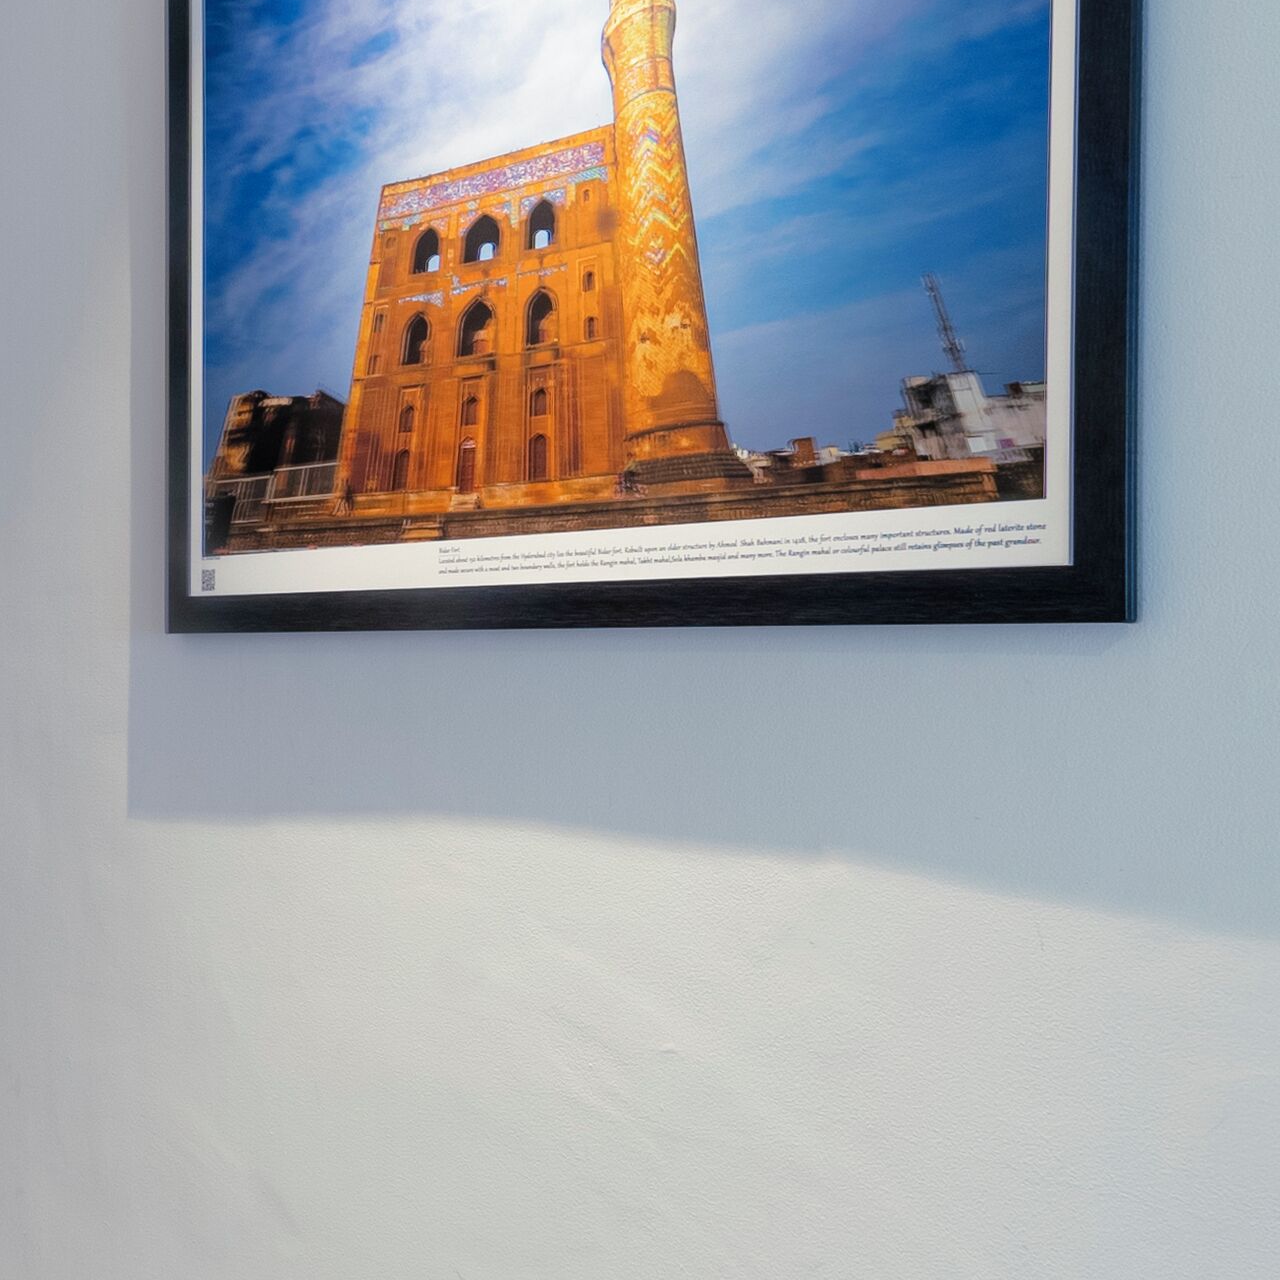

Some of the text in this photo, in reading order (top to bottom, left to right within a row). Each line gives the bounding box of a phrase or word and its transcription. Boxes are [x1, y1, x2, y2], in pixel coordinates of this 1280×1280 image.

[500, 553, 511, 563] from
[547, 551, 555, 560] city
[574, 547, 596, 558] beautiful
[740, 538, 754, 546] Shah
[818, 533, 831, 544] fort
[860, 534, 878, 542] many
[880, 531, 914, 540] important
[954, 525, 973, 534] Made
[975, 524, 984, 536] of
[984, 523, 996, 532] red
[998, 524, 1024, 532] laterite
[501, 563, 510, 571] and
[520, 562, 542, 571] boundary
[565, 560, 575, 570] fort
[727, 551, 739, 559] and
[775, 549, 786, 557] The
[811, 546, 831, 555] mahal
[840, 544, 870, 555] colourful
[871, 544, 892, 554] palace
[893, 542, 907, 551] still
[933, 541, 963, 552] glimpses
[965, 538, 974, 550] of
[974, 538, 986, 547] the
[986, 539, 1003, 549] past
[1004, 536, 1042, 548] grandeur.
